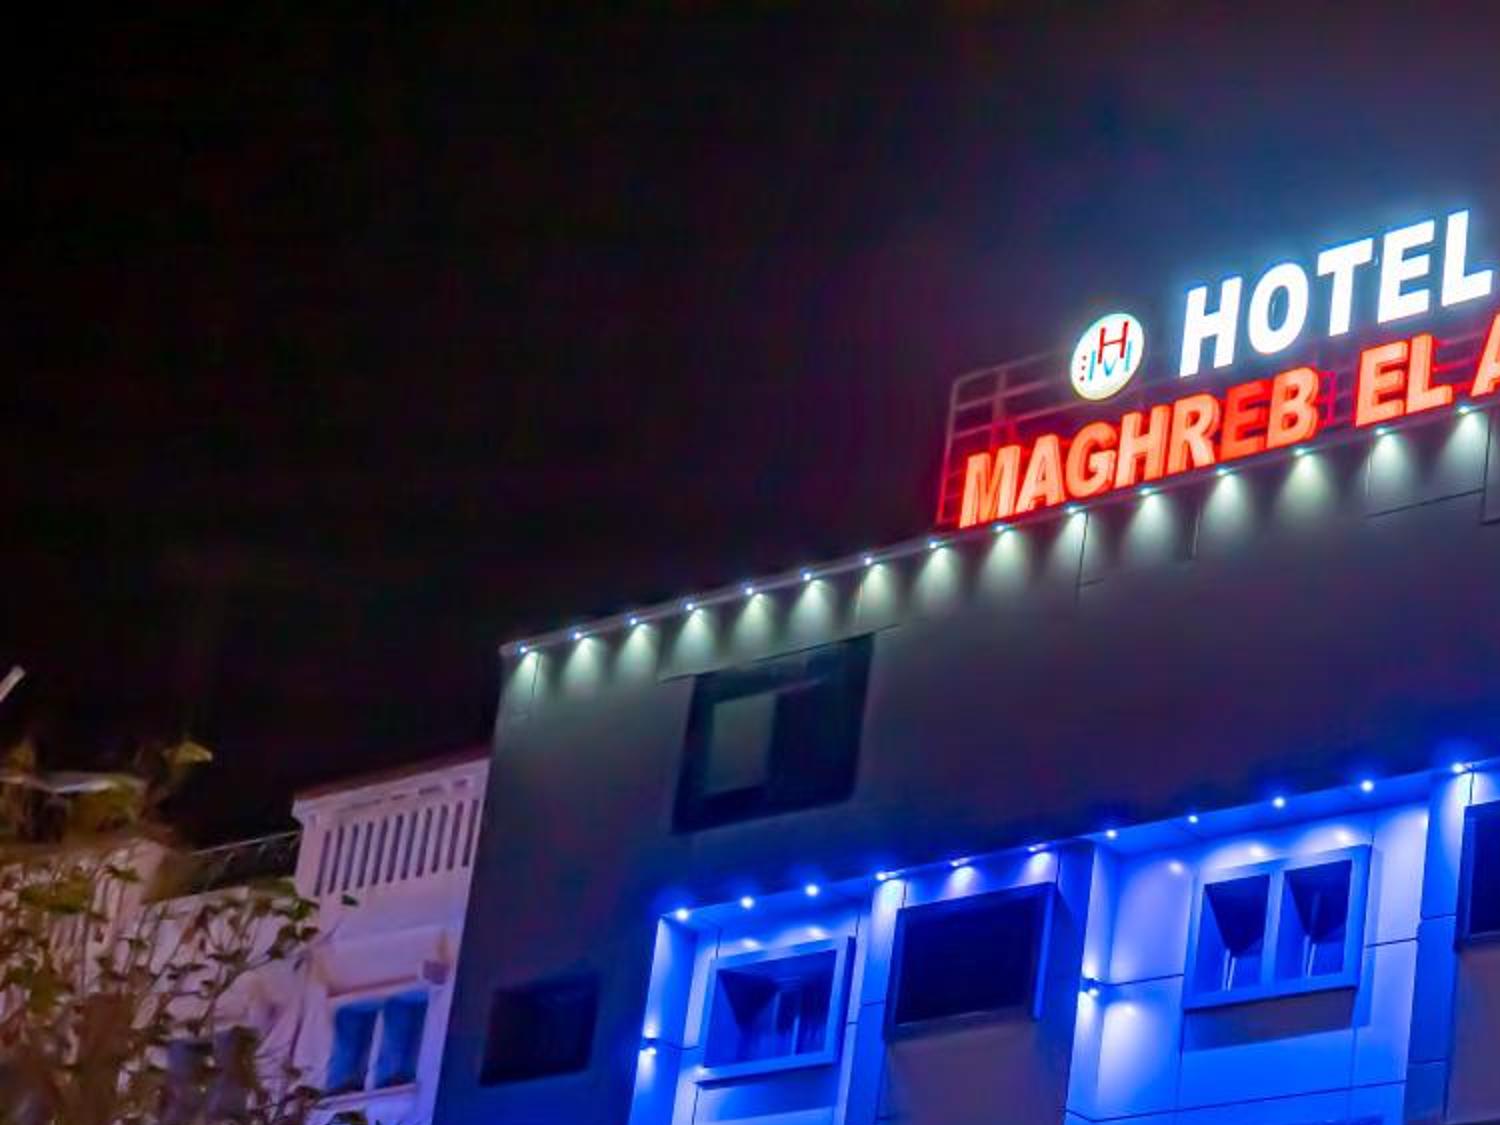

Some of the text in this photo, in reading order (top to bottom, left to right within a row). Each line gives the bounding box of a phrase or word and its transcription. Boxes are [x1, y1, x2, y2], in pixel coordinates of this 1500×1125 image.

[1179, 209, 1493, 377] HOTEL
[959, 366, 1320, 529] MAGHREB
[1355, 333, 1453, 428] EL
